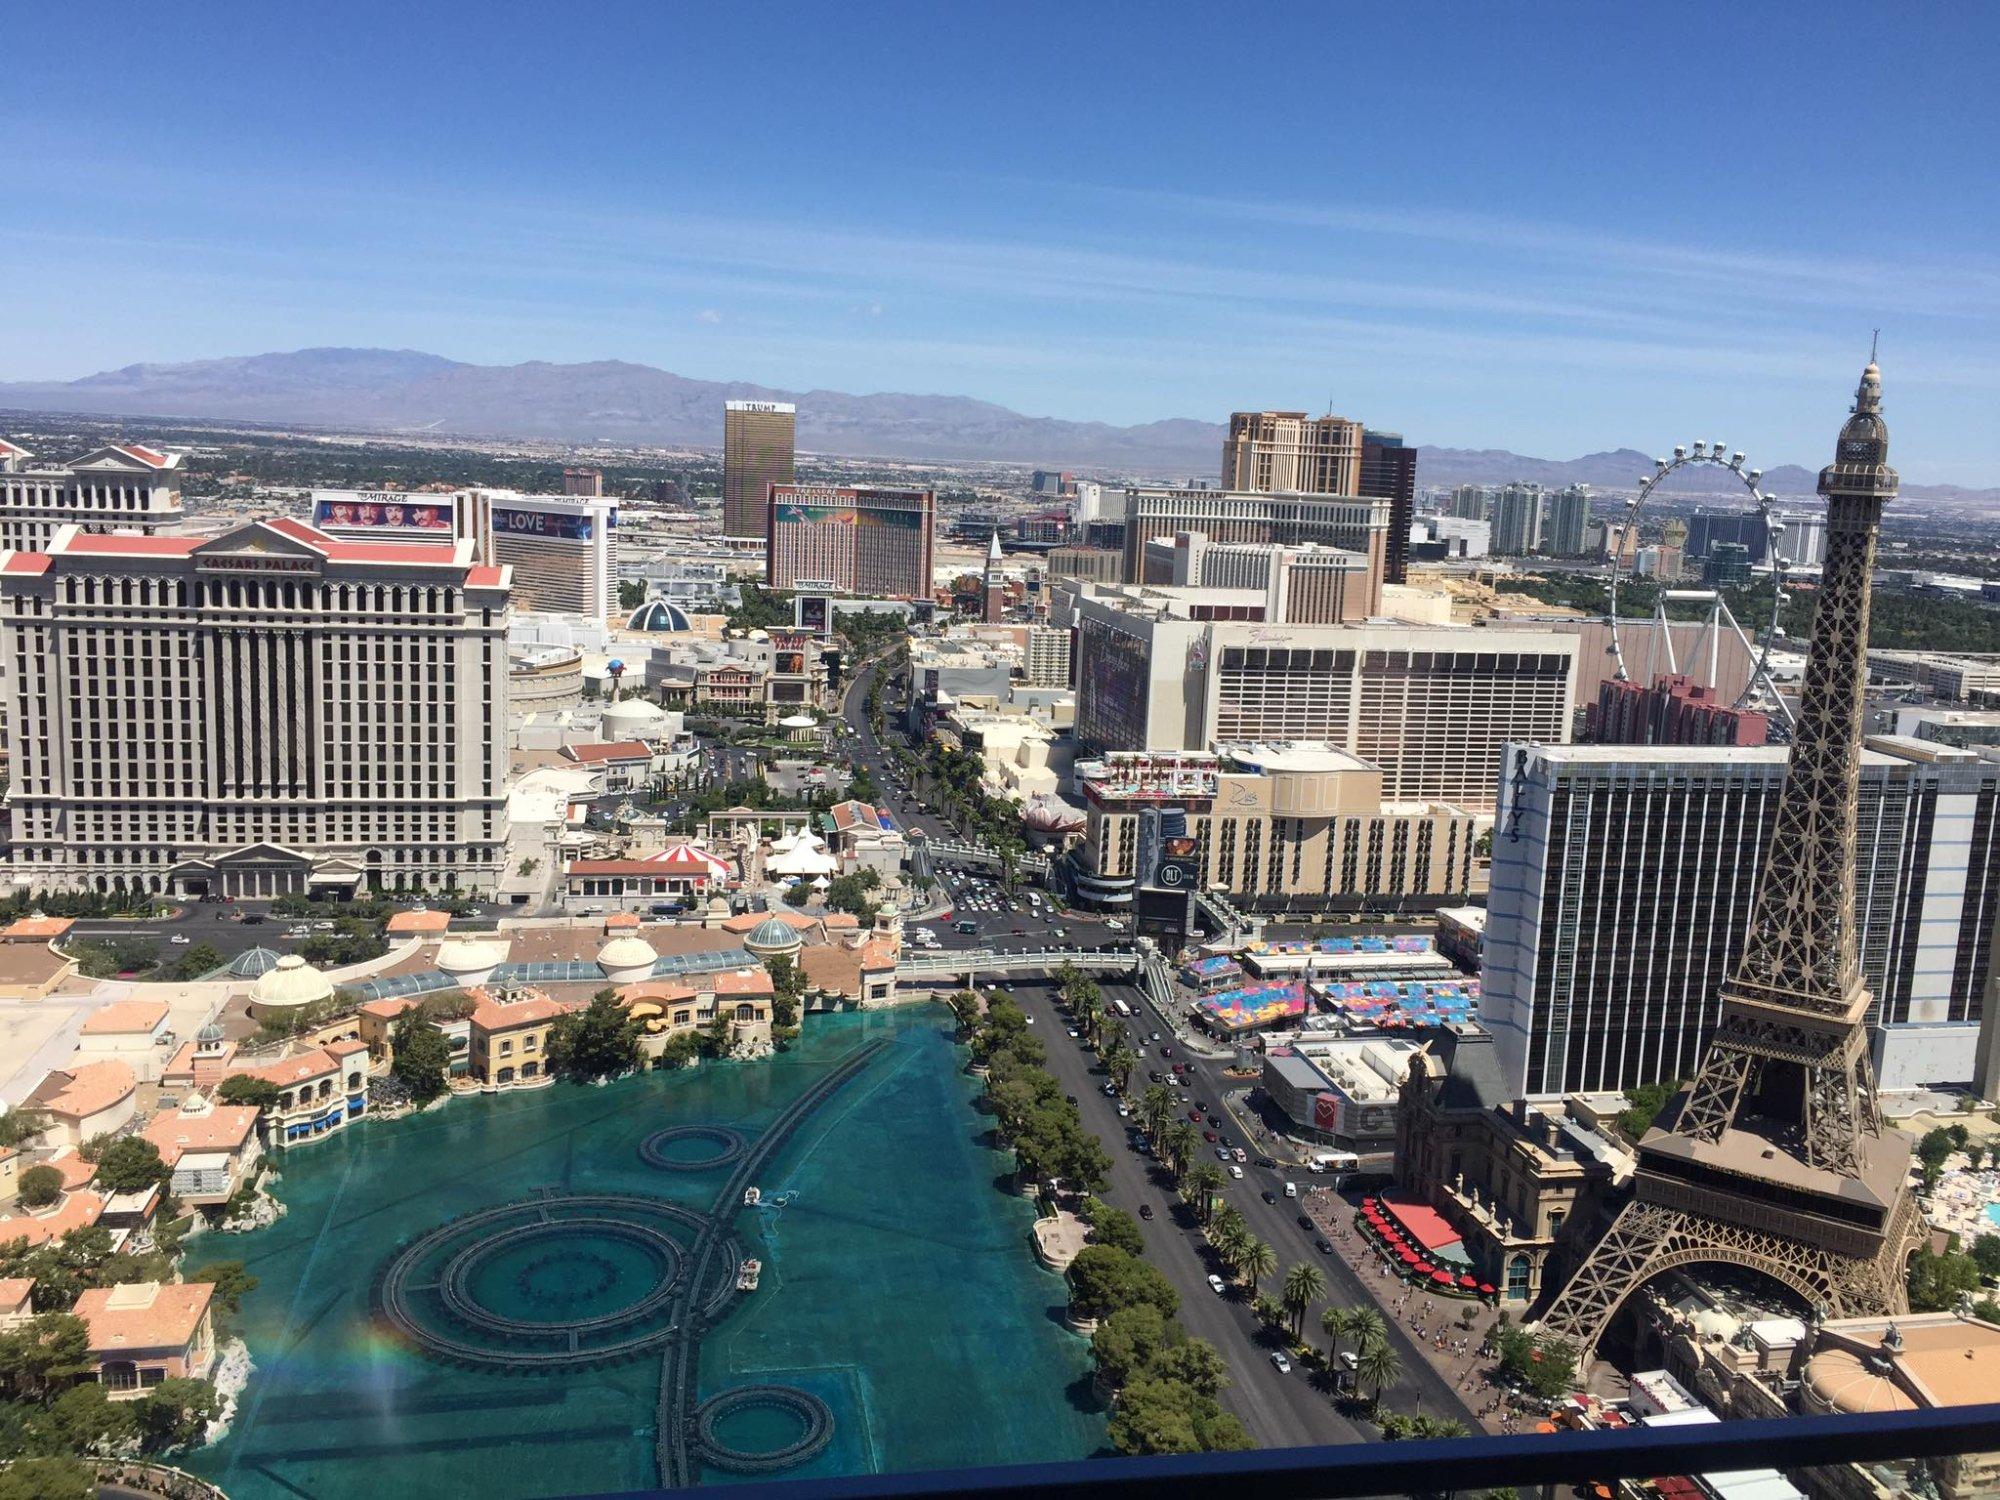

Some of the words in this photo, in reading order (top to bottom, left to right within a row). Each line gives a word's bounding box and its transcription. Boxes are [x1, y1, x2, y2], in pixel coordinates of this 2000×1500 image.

[746, 403, 776, 412] TRUMP
[367, 493, 408, 503] MIRAGE
[508, 512, 545, 531] LOVE
[203, 558, 260, 569] CAESARS
[265, 559, 315, 571] PALACE
[1165, 869, 1179, 882] BLT
